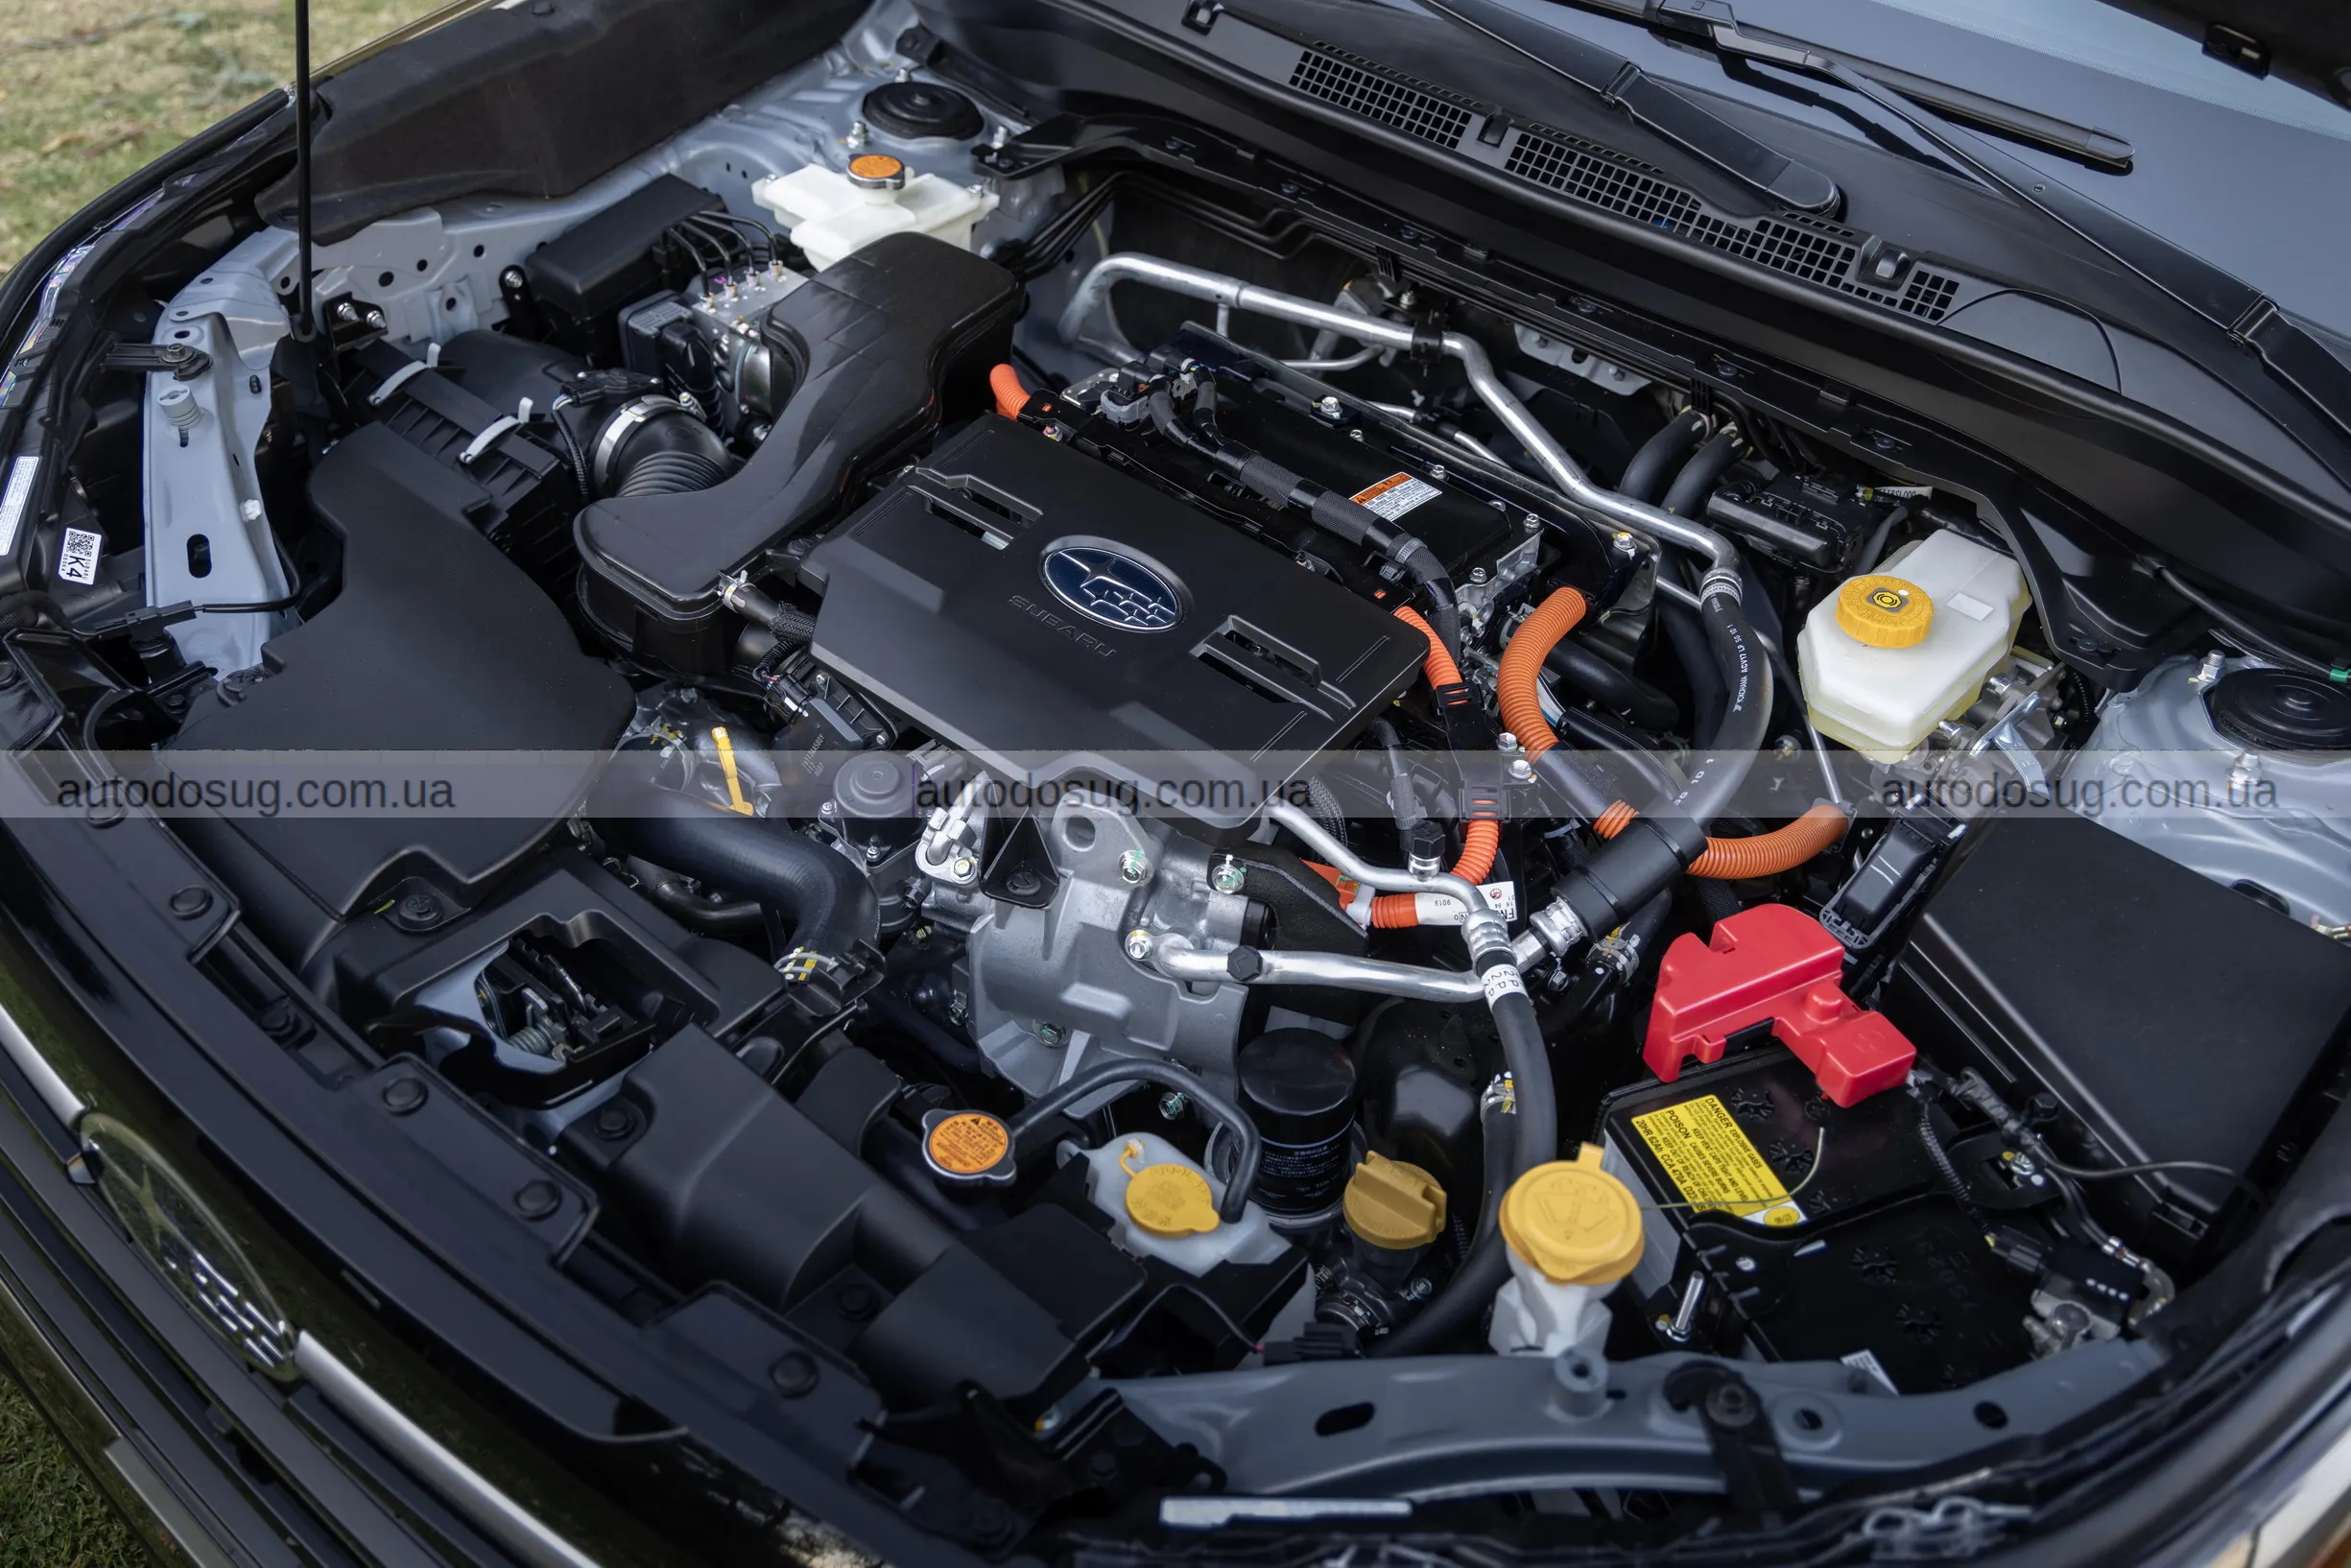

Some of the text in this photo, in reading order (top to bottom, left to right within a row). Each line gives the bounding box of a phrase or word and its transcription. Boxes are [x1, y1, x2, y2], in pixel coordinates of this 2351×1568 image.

[66, 556, 86, 578] K4
[1008, 595, 1117, 658] SUBARU
[1736, 675, 1748, 704] YOKOHAMA
[1664, 1109, 1692, 1139] POISON
[1704, 1097, 1733, 1128] DANGER
[1690, 1127, 1705, 1141] KEEP
[1659, 1152, 1676, 1169] CCA
